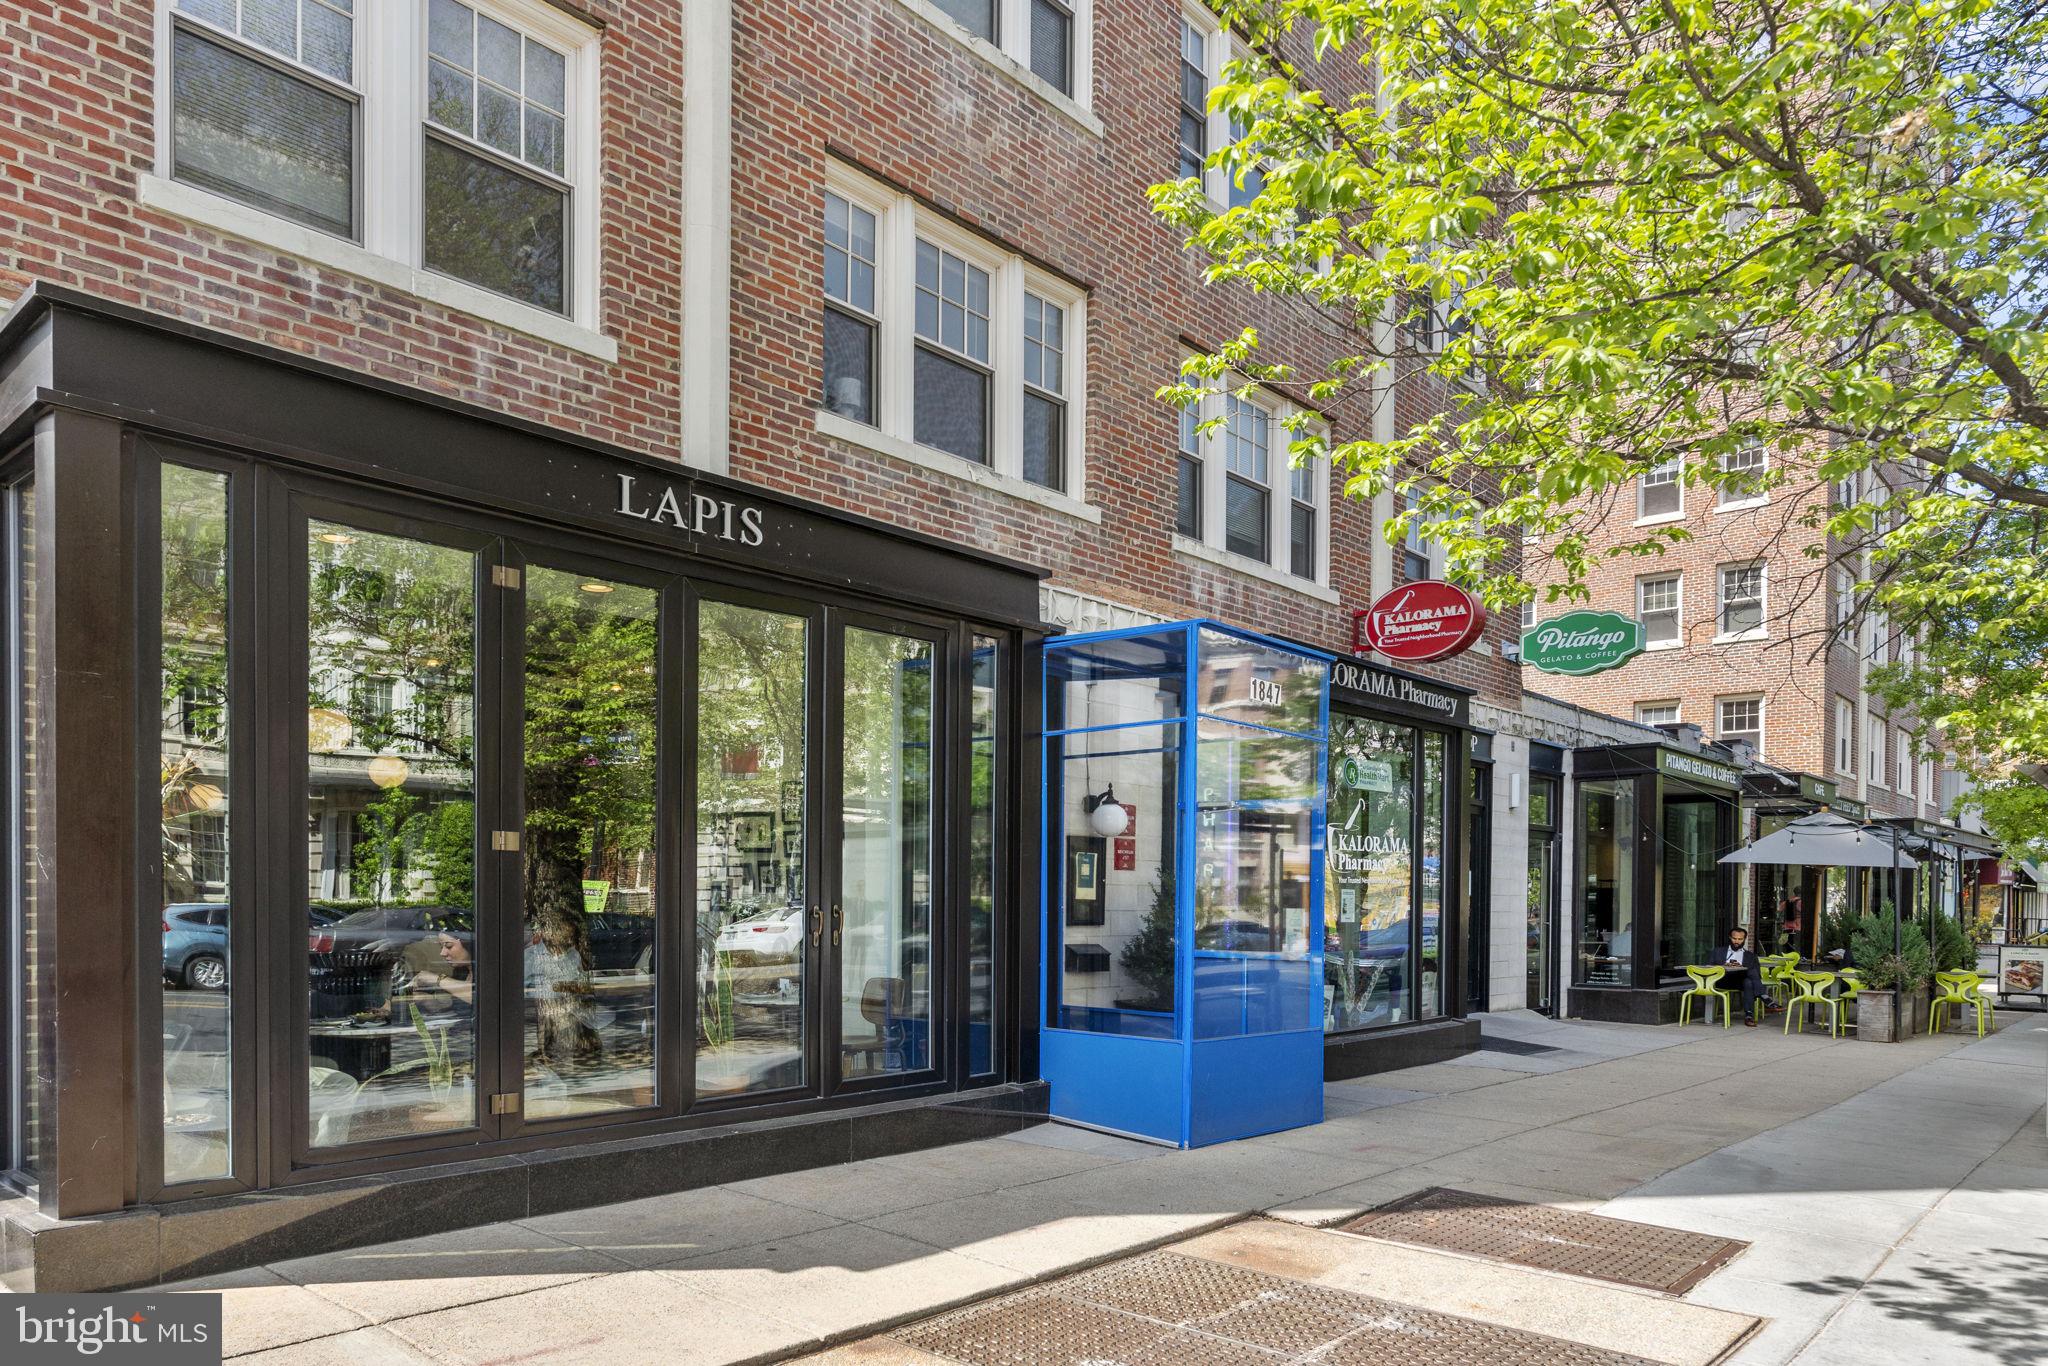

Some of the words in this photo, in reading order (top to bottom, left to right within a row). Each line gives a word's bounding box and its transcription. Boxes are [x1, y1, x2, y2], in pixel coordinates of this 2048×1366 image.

[617, 473, 764, 546] LAPIS
[1384, 604, 1468, 625] KALORAMA
[1384, 620, 1443, 636] Pharmacy
[1394, 635, 1410, 643] Trusted
[1441, 629, 1464, 638] Pharmacy
[1537, 626, 1626, 653] Pitango
[1540, 654, 1573, 663] GELATO
[1585, 650, 1617, 659] COFFEE
[1252, 678, 1281, 705] 1847
[1400, 678, 1458, 718] Pharmacy
[1665, 753, 1692, 773] PITANGO
[1692, 760, 1712, 778] GELATO
[1712, 766, 1717, 780] &
[1717, 767, 1737, 784] COFFEE
[1338, 834, 1408, 854] KALORAMA
